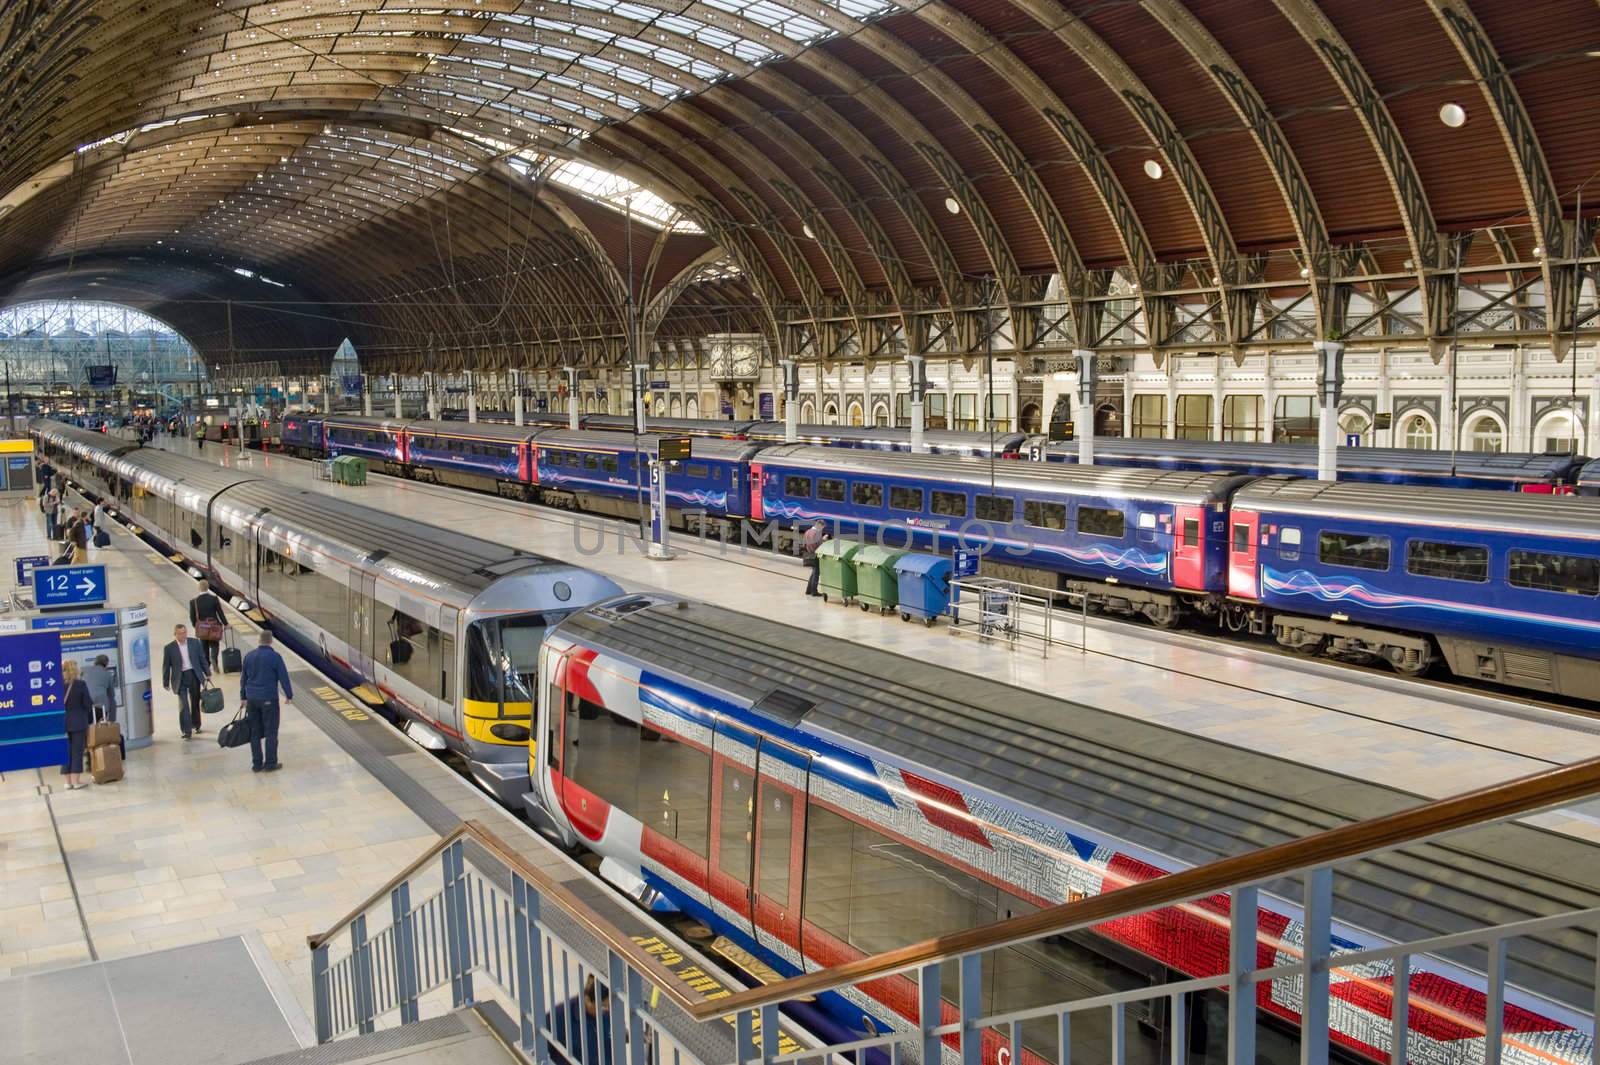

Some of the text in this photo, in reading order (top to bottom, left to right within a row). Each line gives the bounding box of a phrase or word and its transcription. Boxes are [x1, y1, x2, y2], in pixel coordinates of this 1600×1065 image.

[1350, 436, 1356, 447] 1
[1032, 448, 1039, 461] 3
[653, 468, 658, 483] 5
[46, 575, 69, 591] 12
[64, 617, 90, 626] express
[1417, 1042, 1450, 1064] Czech
